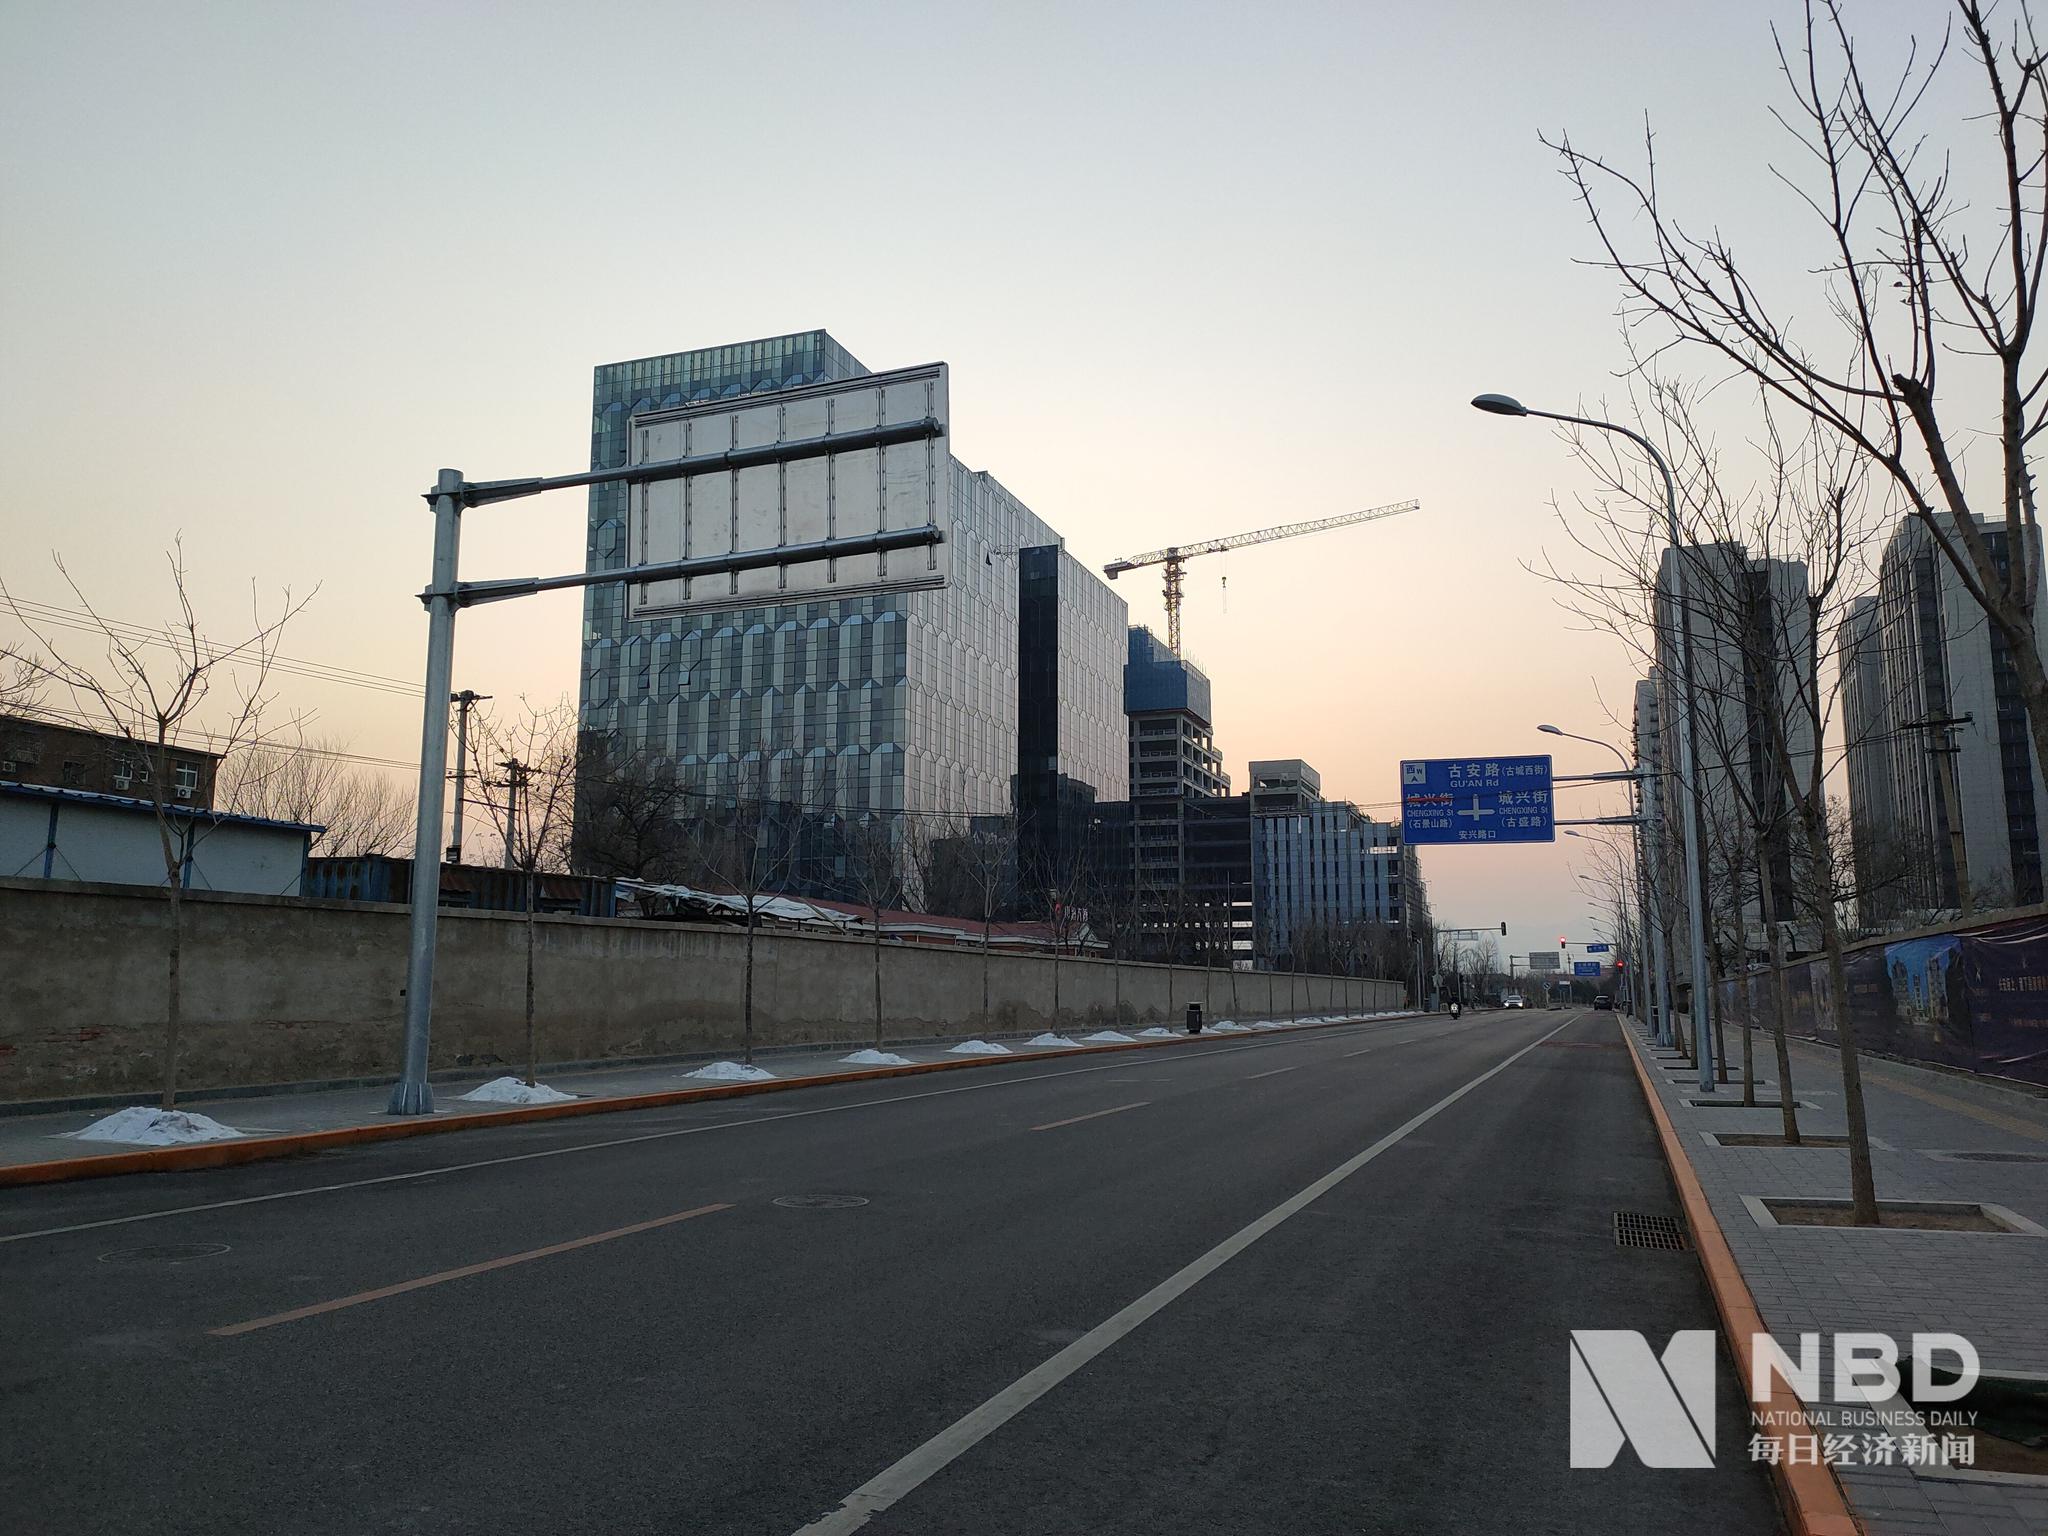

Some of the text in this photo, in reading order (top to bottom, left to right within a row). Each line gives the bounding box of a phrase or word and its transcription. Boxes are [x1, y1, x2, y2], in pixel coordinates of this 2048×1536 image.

[1448, 763, 1501, 778] 古安路
[1450, 779, 1499, 788] GU'AN Rd
[1498, 790, 1548, 805] 城兴街
[1407, 809, 1444, 817] CHENGXING
[1499, 806, 1538, 814] CHENGXING
[1458, 830, 1496, 840] 安兴路口
